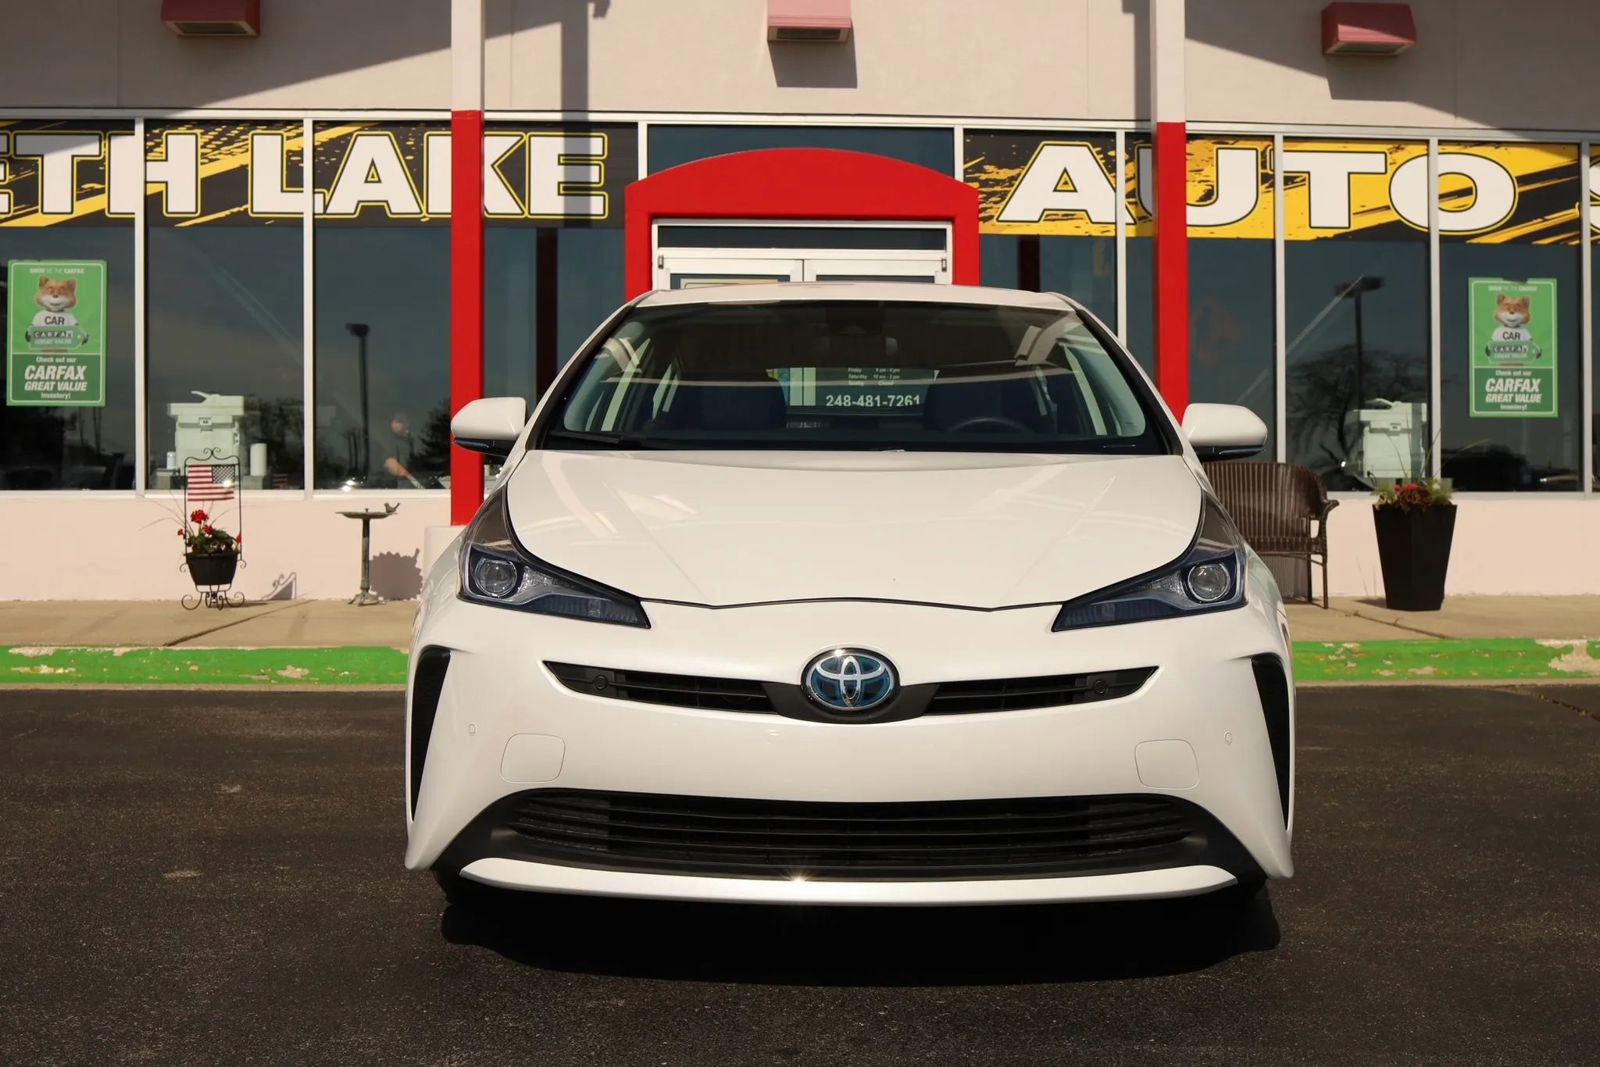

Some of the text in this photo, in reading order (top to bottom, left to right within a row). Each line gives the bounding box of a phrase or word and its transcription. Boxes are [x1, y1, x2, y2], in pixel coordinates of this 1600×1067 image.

[0, 131, 200, 217] TH
[248, 131, 609, 219] LAKE
[995, 141, 1519, 235] AUTO
[44, 316, 65, 325] CAR
[1502, 331, 1521, 340] CAR
[24, 365, 88, 380] CARFAX
[24, 381, 88, 391] GREAT VALUE
[1485, 378, 1541, 392] CARFAX
[825, 394, 920, 407] 248-481-7261
[1485, 393, 1542, 403] GREAT VALUE
